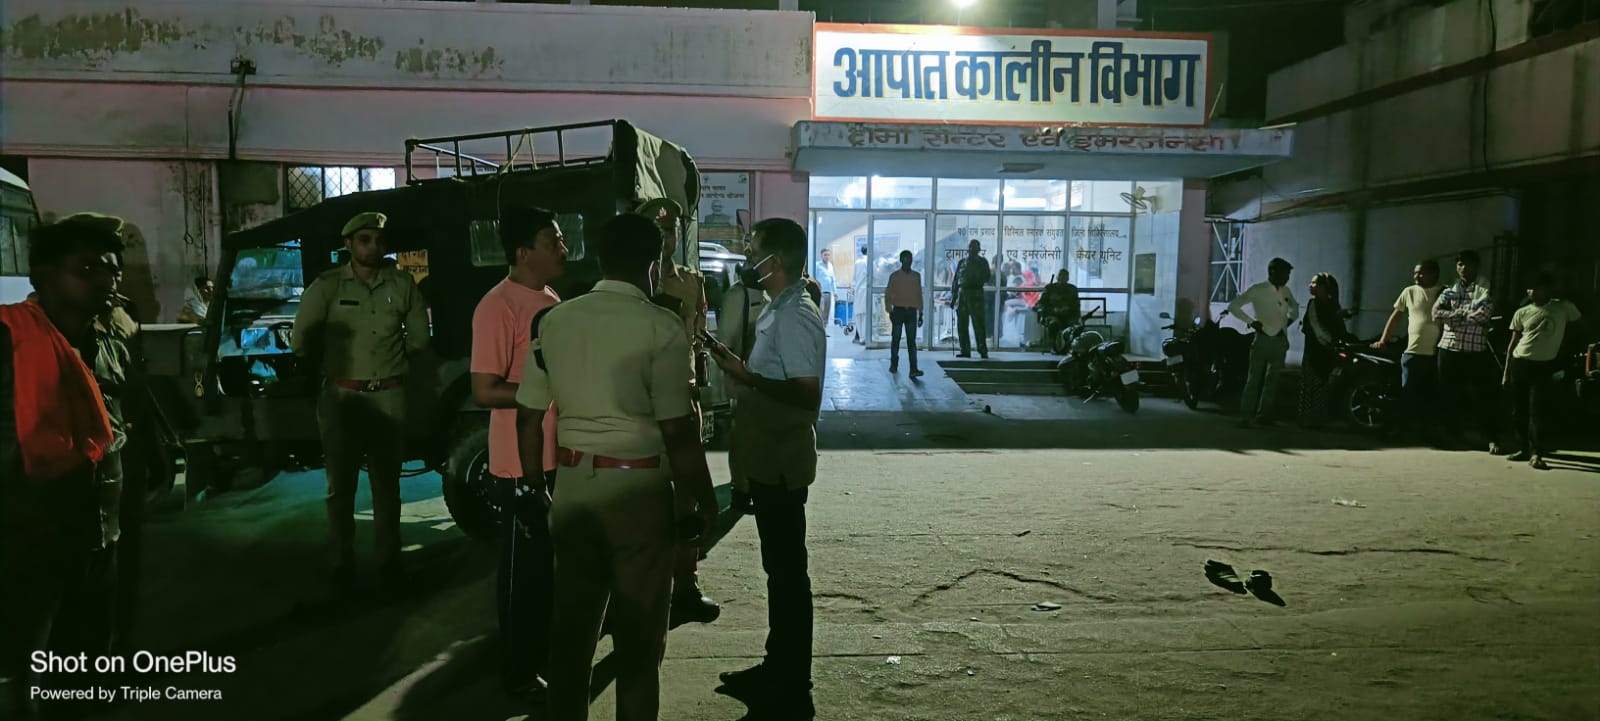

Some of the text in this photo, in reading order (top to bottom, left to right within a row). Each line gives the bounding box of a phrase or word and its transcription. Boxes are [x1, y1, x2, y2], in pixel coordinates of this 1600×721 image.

[833, 39, 1201, 107] आपात कालीन विभाग
